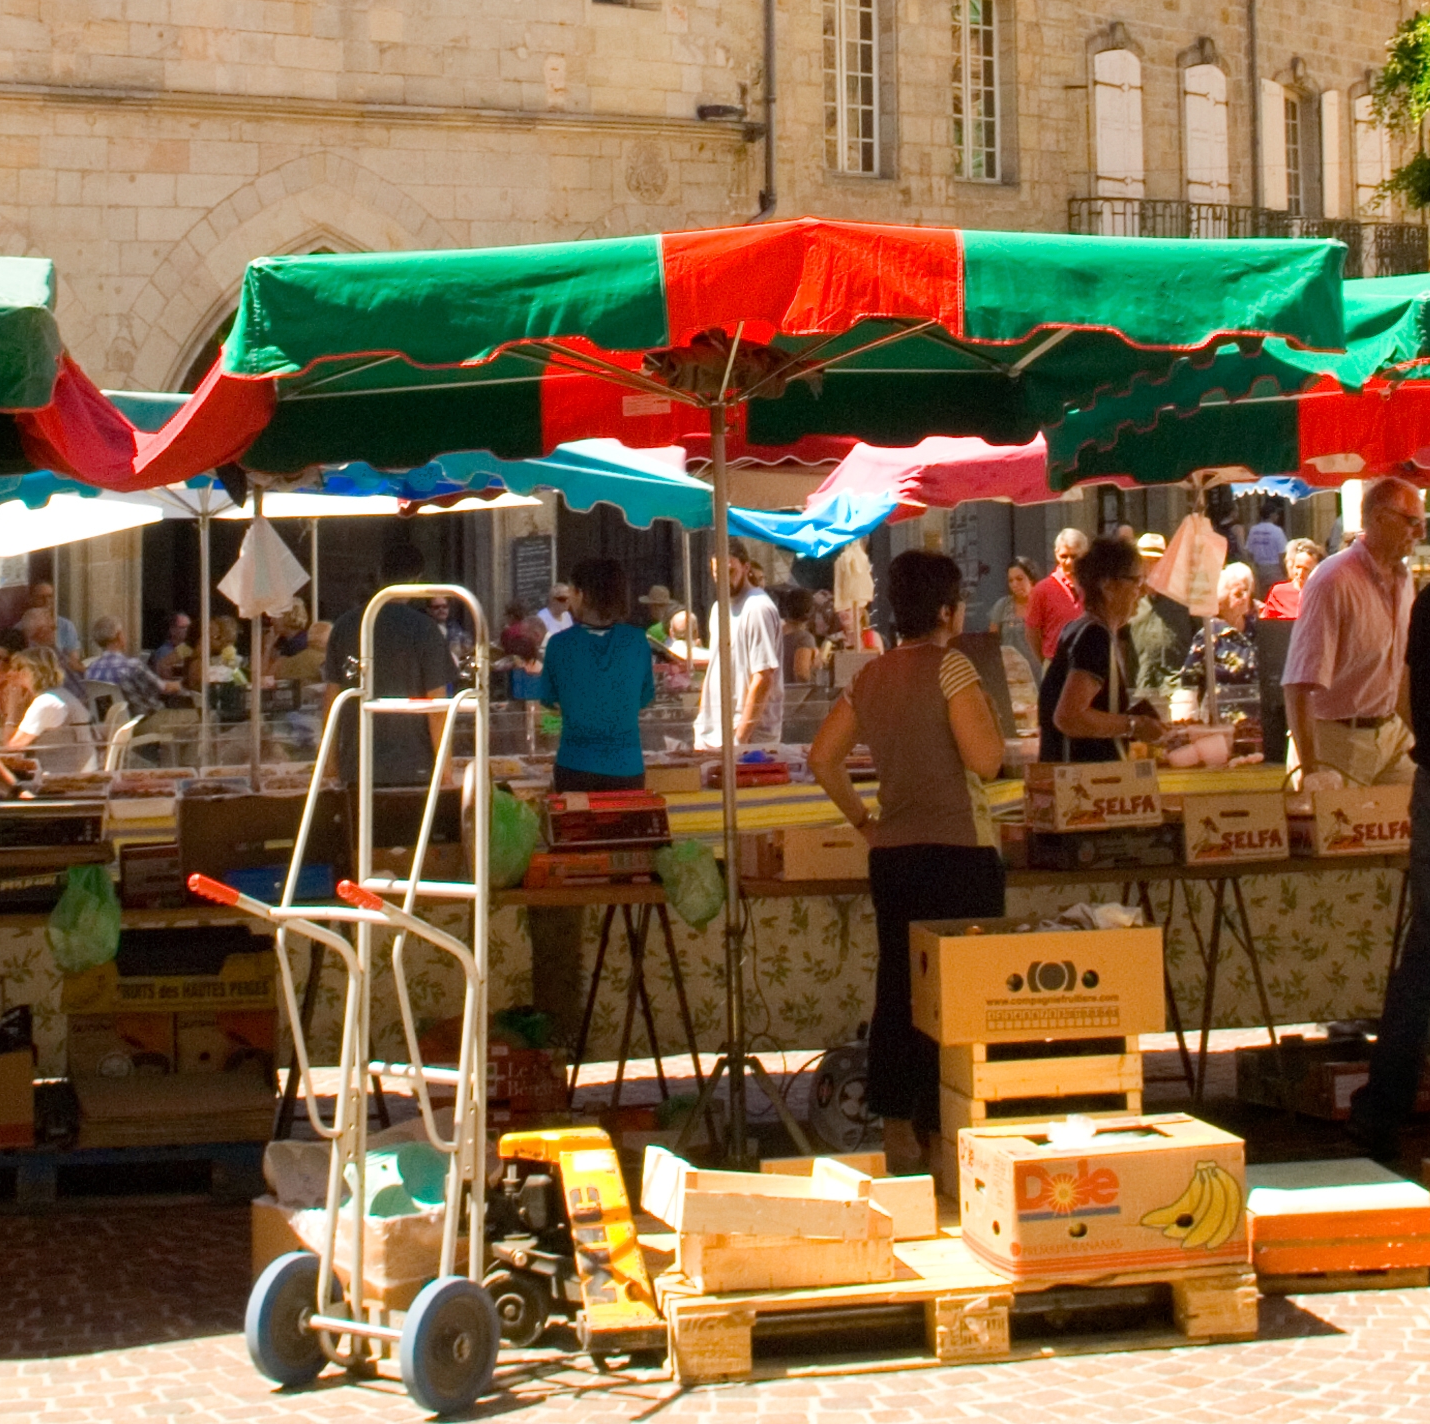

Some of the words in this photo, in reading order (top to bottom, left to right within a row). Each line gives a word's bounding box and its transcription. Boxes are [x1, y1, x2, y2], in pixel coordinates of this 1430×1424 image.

[1092, 794, 1156, 816] SELFA
[1221, 828, 1284, 849] SELFA
[1352, 820, 1411, 841] SELFA
[986, 994, 1119, 1006] www.compagniefruitiere.com
[1015, 1159, 1120, 1213] Dole
